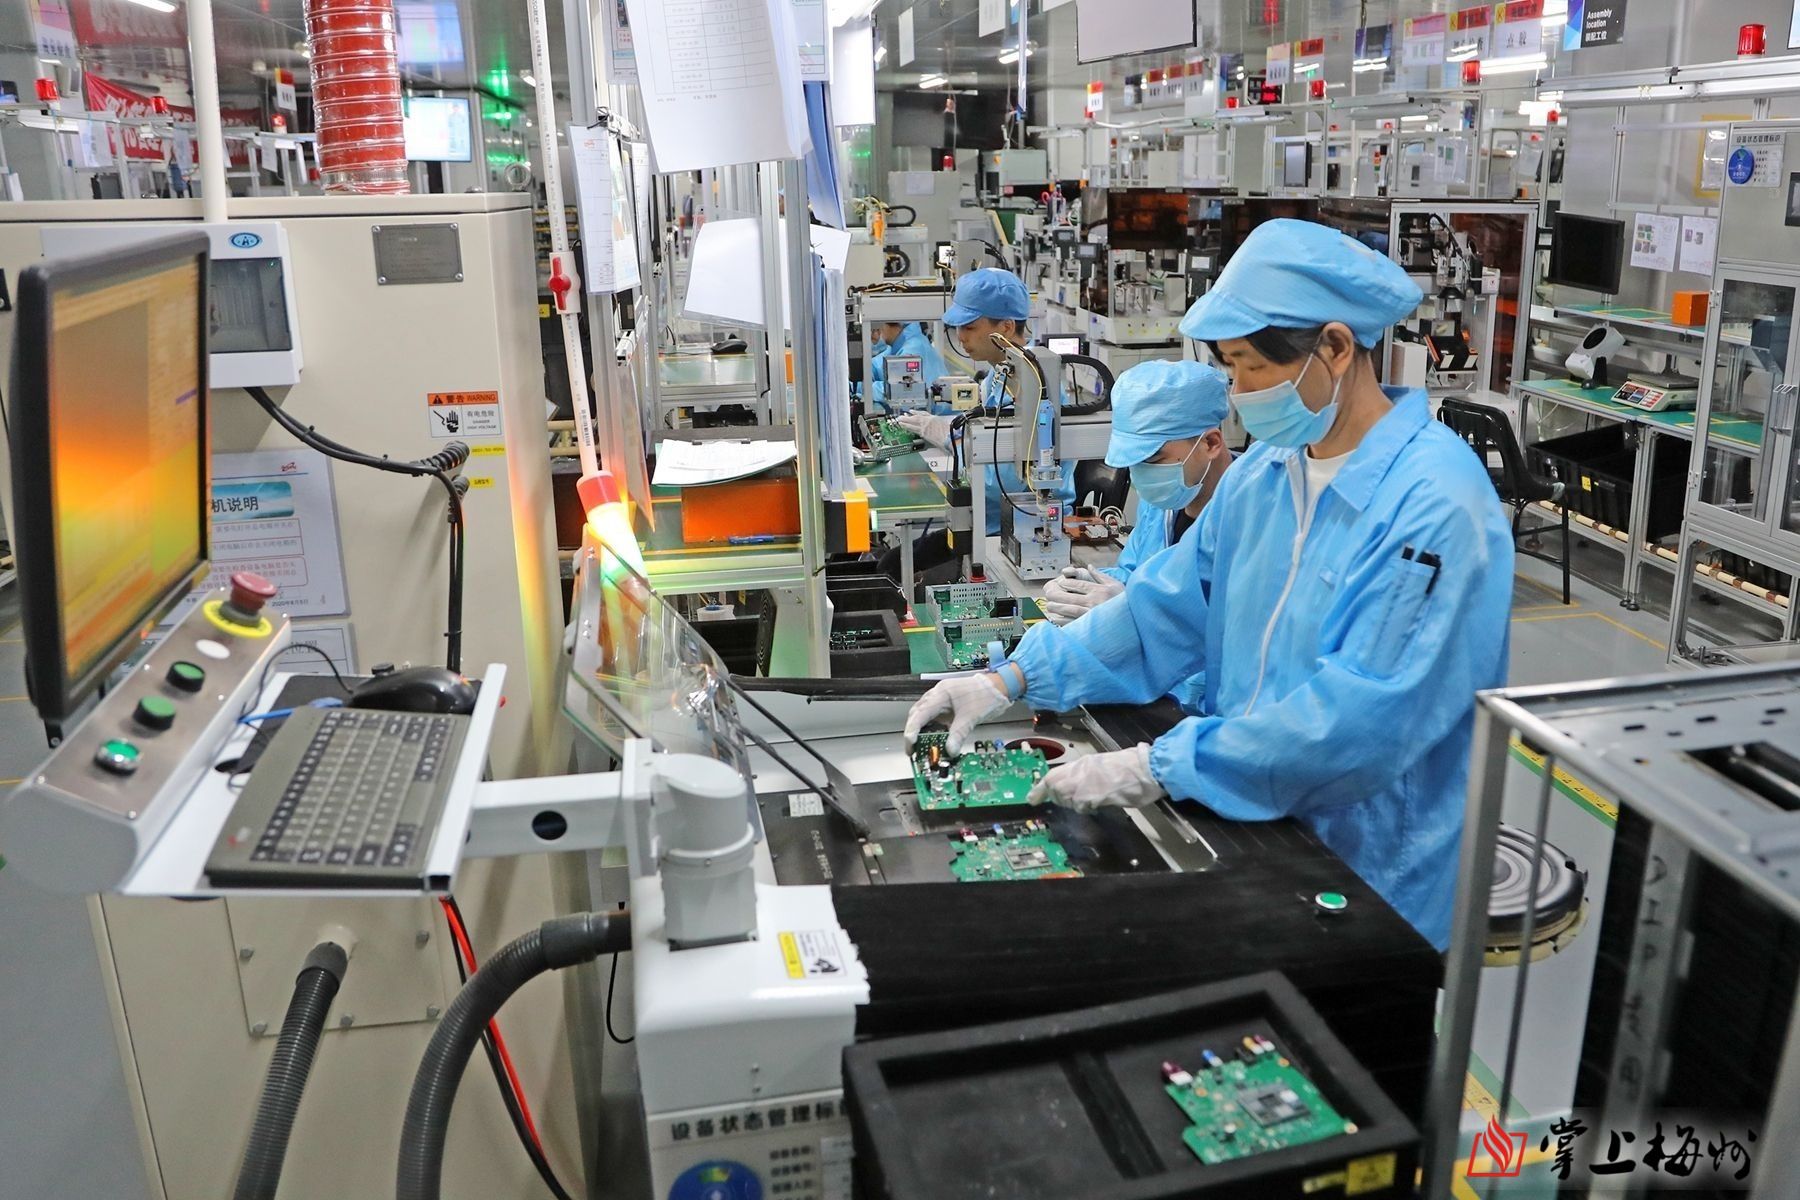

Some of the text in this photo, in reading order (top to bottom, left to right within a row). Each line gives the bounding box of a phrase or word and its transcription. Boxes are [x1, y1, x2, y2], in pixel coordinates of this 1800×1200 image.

[1586, 8, 1612, 20] Assembly
[1586, 19, 1607, 29] location
[1585, 30, 1608, 42] 装配工位
[446, 393, 496, 403] 警告 WARNING
